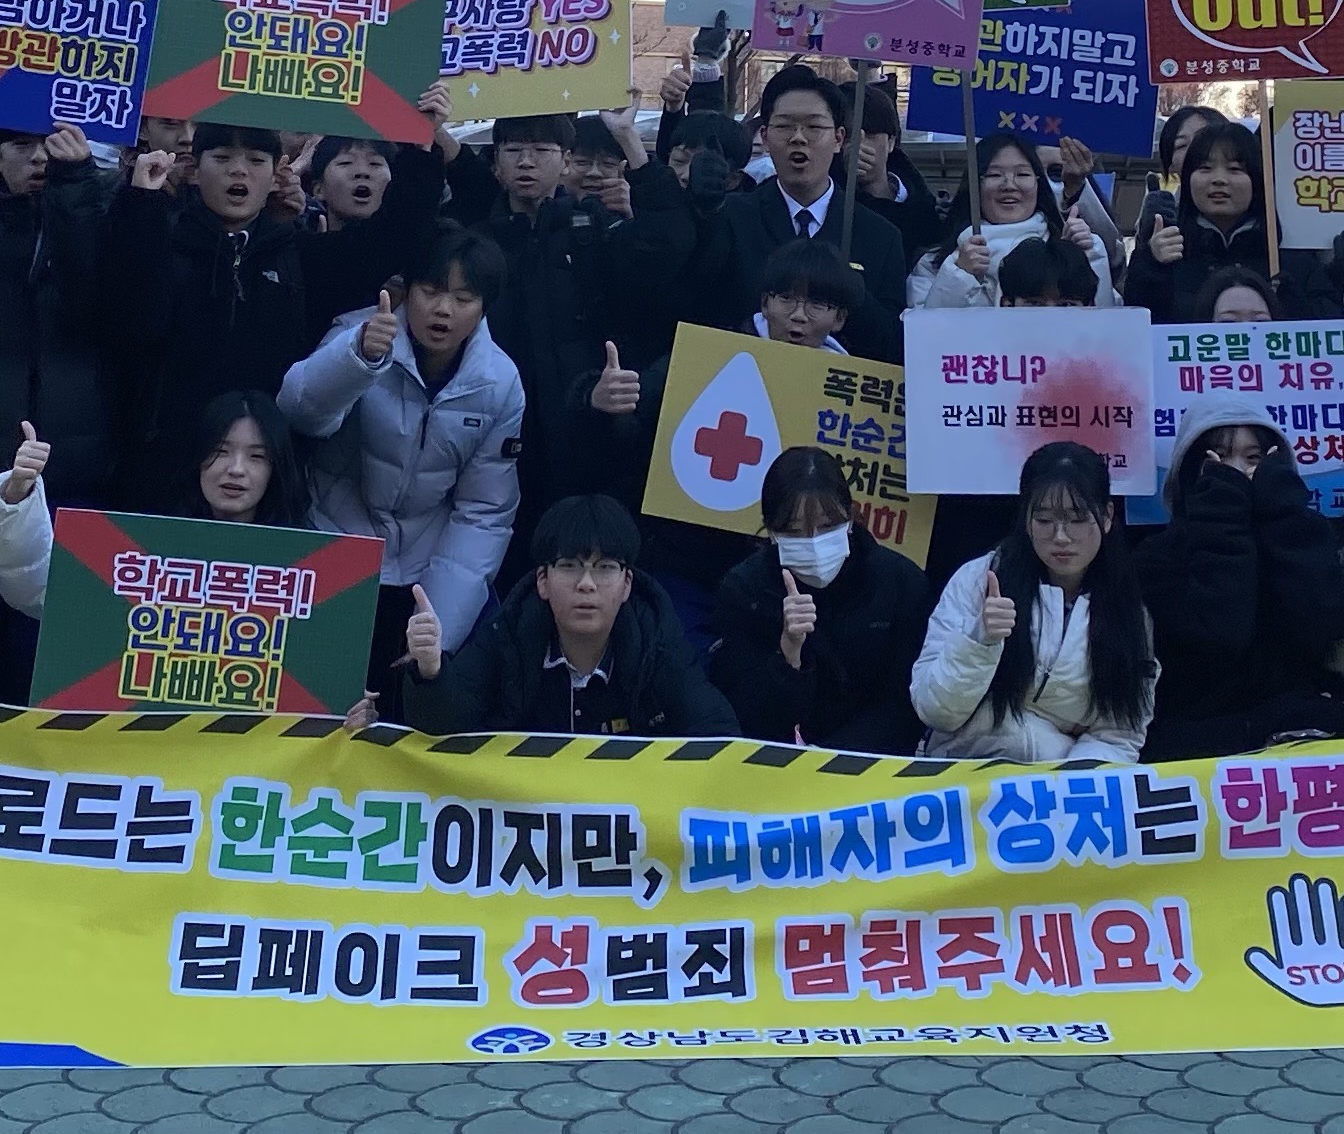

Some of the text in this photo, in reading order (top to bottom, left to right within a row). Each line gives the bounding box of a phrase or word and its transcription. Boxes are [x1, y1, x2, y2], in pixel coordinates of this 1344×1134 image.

[223, 8, 367, 63] 안돼요!
[538, 27, 590, 61] NO
[889, 36, 967, 59] 분성중학교
[979, 19, 1137, 66] 관하지말고
[218, 48, 363, 104] 나빠요!
[1185, 57, 1261, 76] 분성중학교
[50, 78, 131, 128] 말자
[1071, 69, 1139, 107] 되자
[941, 354, 1047, 384] 괜찮니?
[1167, 333, 1252, 363] 고운말
[1279, 361, 1344, 392] 치유,
[942, 404, 1134, 430] 관심과 표현의 시작
[113, 550, 316, 620] 학교폭력!
[128, 604, 289, 664] 안돼요!
[118, 651, 282, 713] 나빠요!
[219, 784, 665, 900] 한순간이지만,
[687, 788, 967, 883] 피해자의
[987, 771, 1200, 866] 상처는
[178, 904, 1195, 1006] 딥페이크 성범죄 멈춰주세요!
[564, 1023, 1112, 1049] 경상남도김해교육지원청
